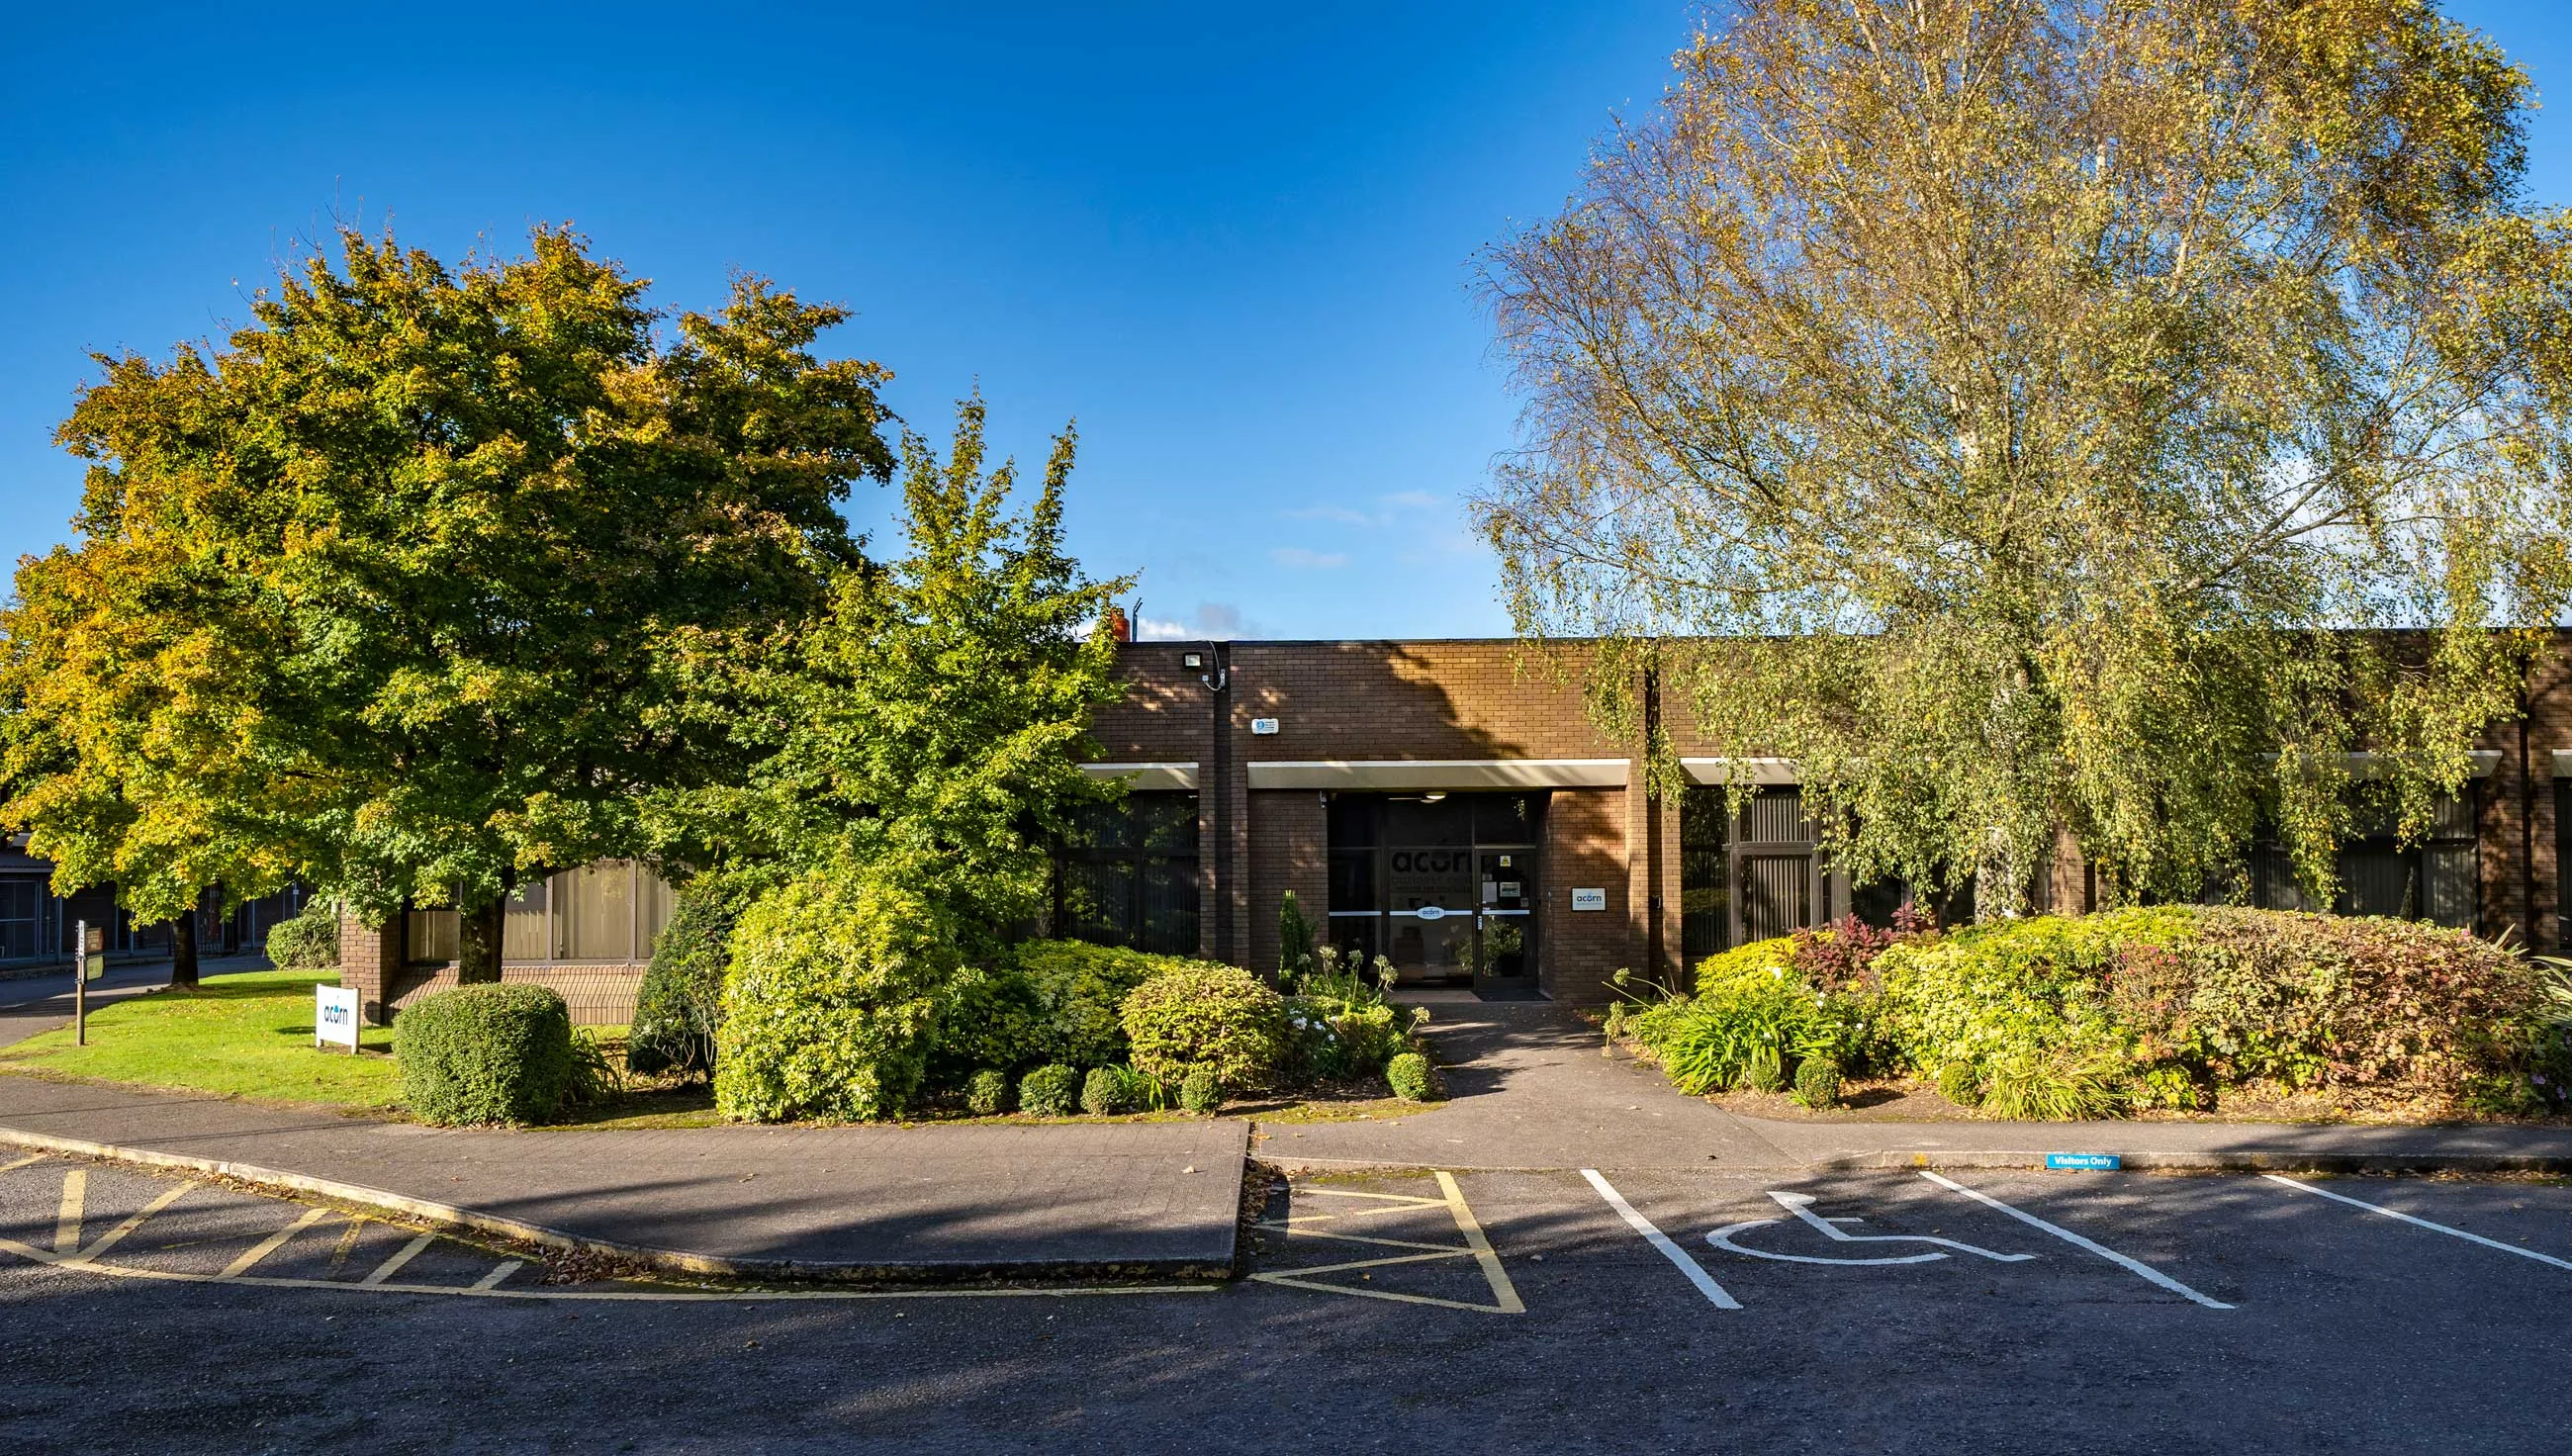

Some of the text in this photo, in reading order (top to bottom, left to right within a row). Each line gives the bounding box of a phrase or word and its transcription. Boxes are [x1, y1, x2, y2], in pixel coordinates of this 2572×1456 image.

[1577, 893, 1602, 902] acorn
[324, 1005, 348, 1026] acorn
[2055, 1155, 2113, 1167] Visitors Only
